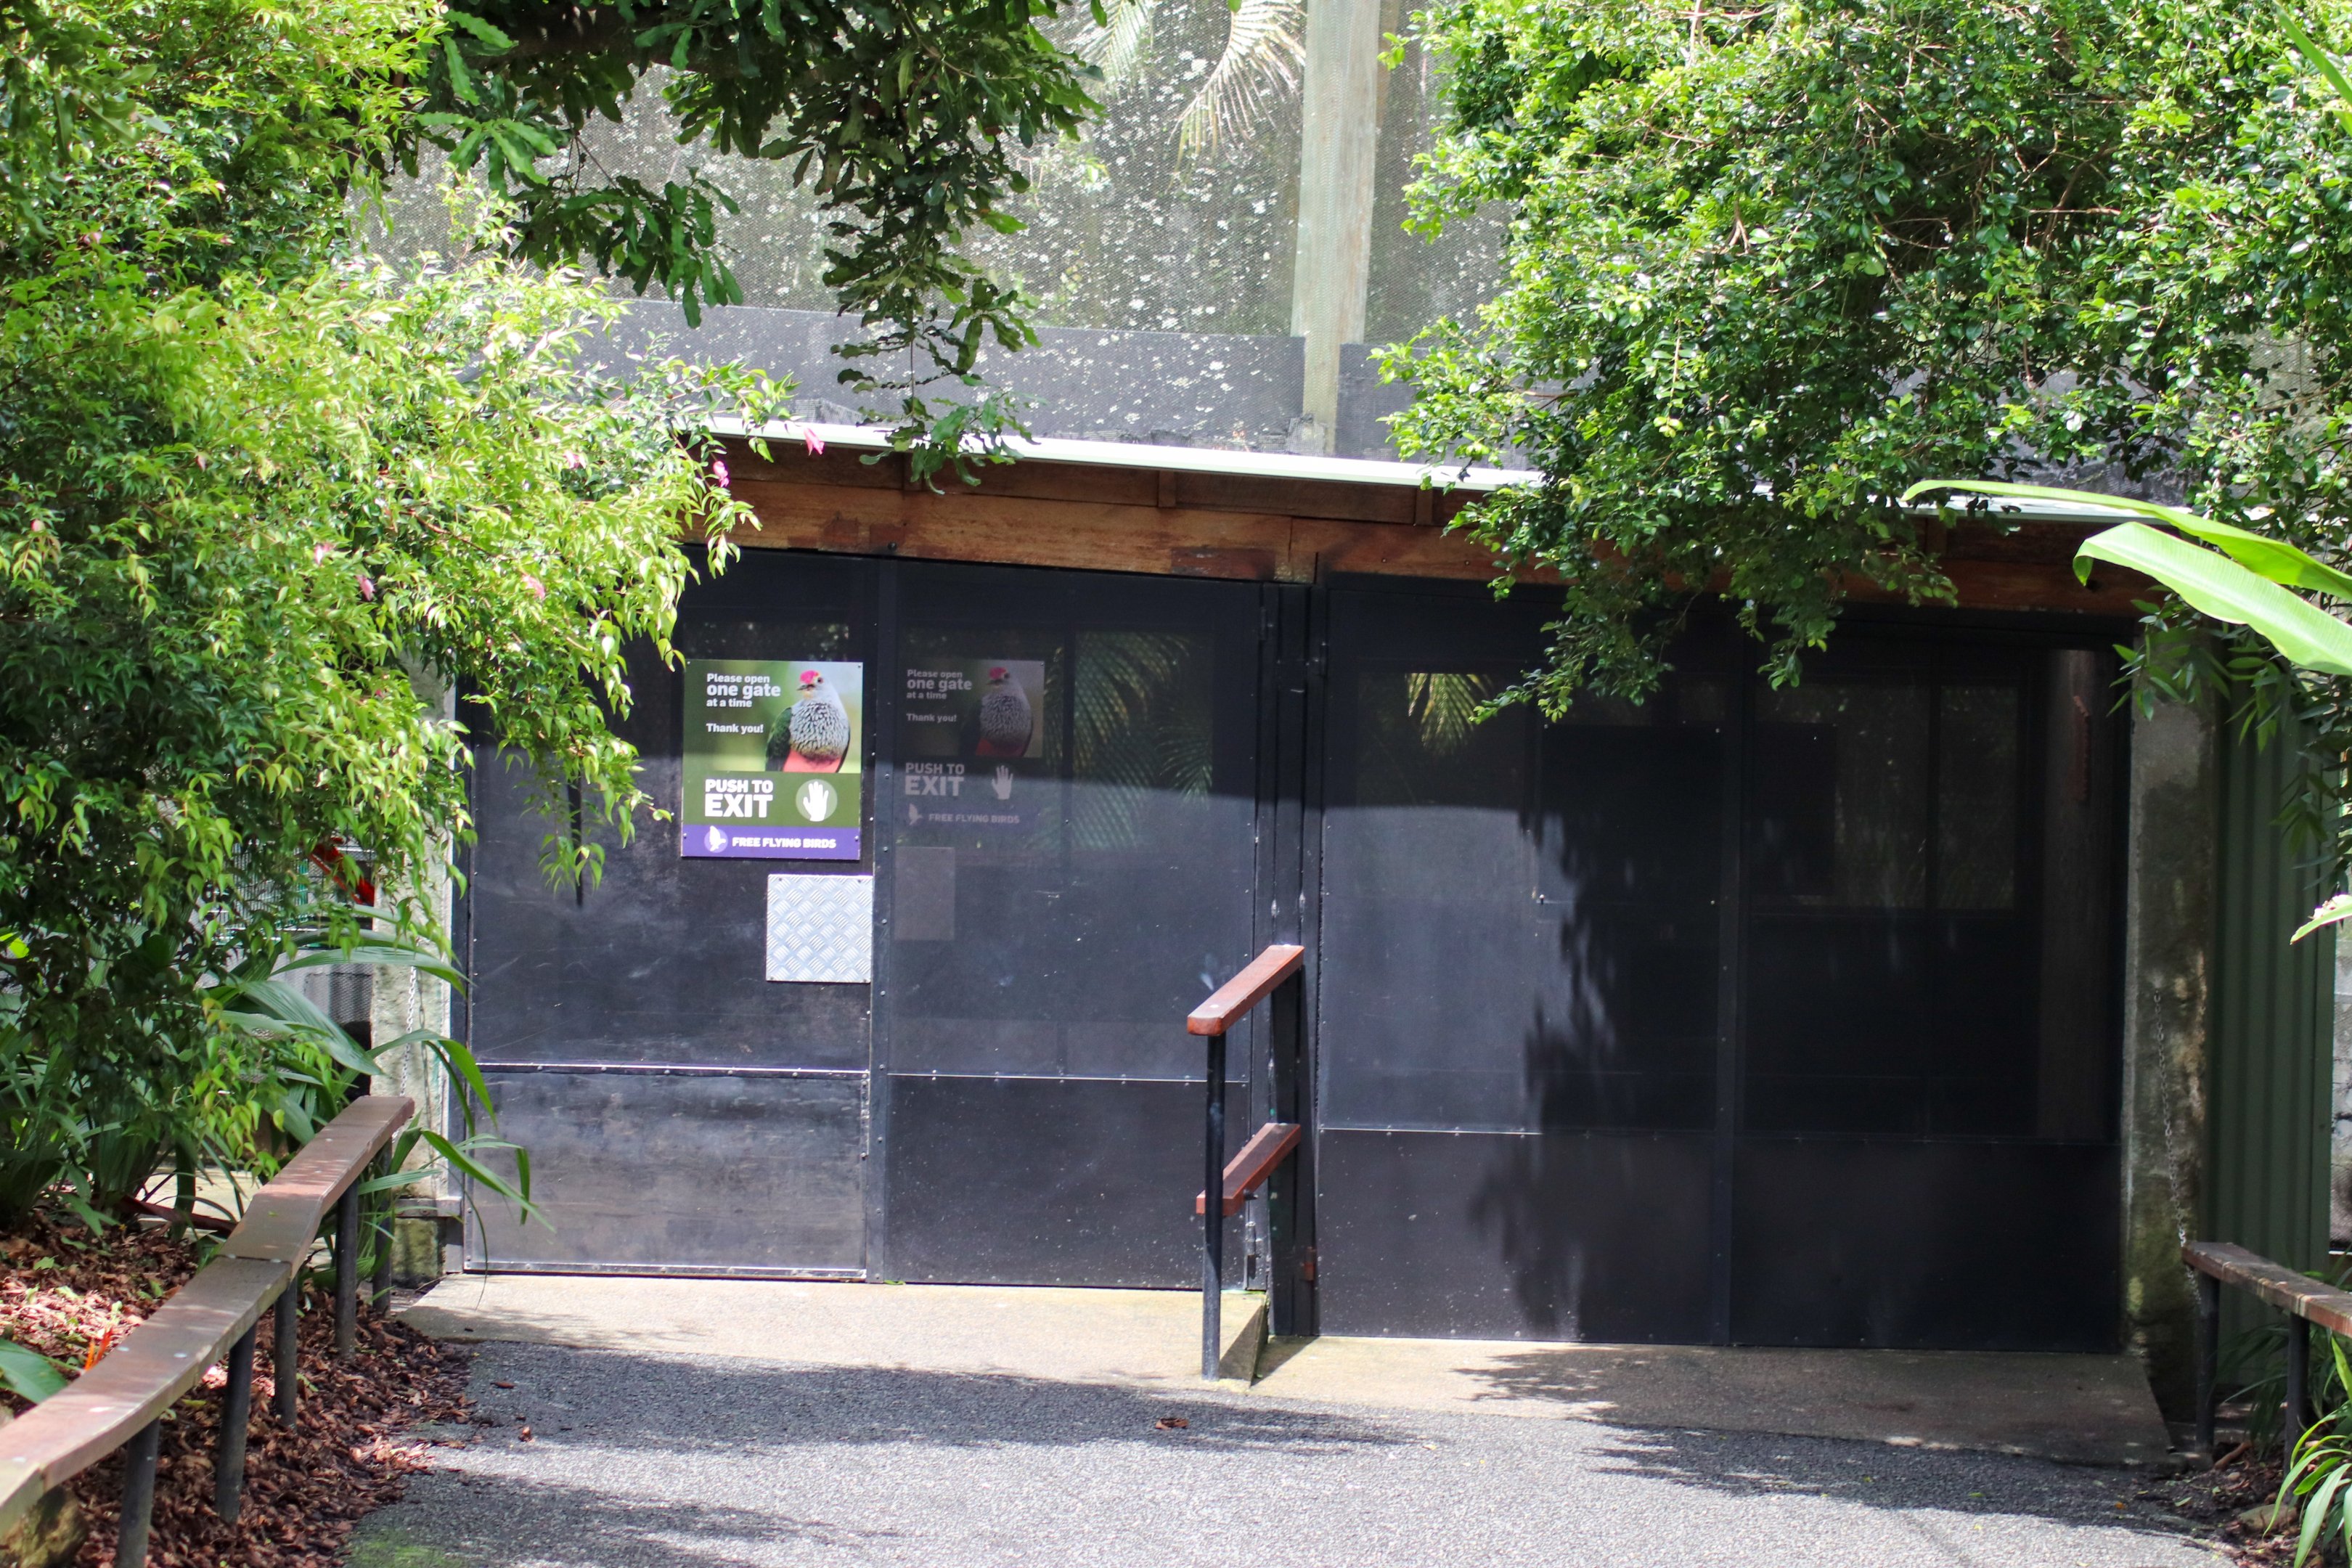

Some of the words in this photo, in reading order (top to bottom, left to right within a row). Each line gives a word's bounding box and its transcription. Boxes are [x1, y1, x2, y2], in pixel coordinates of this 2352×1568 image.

[707, 673, 742, 683] Please
[744, 675, 770, 685] open
[907, 669, 938, 678] Please
[940, 671, 963, 679] open
[706, 685, 738, 696] one
[742, 683, 781, 700] gate
[907, 679, 934, 690] one
[939, 678, 973, 693] gate
[926, 691, 947, 700] time
[706, 698, 718, 708] at
[728, 698, 753, 708] time
[937, 714, 957, 724] you!
[706, 723, 739, 733] Thank
[740, 723, 764, 735] you!
[905, 762, 943, 775] PUSH
[947, 763, 965, 775] TO
[705, 779, 748, 793] PUSH
[751, 780, 774, 793] TO
[904, 775, 965, 797] EXIT
[704, 793, 774, 818] EXIT
[732, 836, 761, 848] FREE
[762, 836, 801, 849] FLYING
[802, 837, 837, 849] BIRDS
